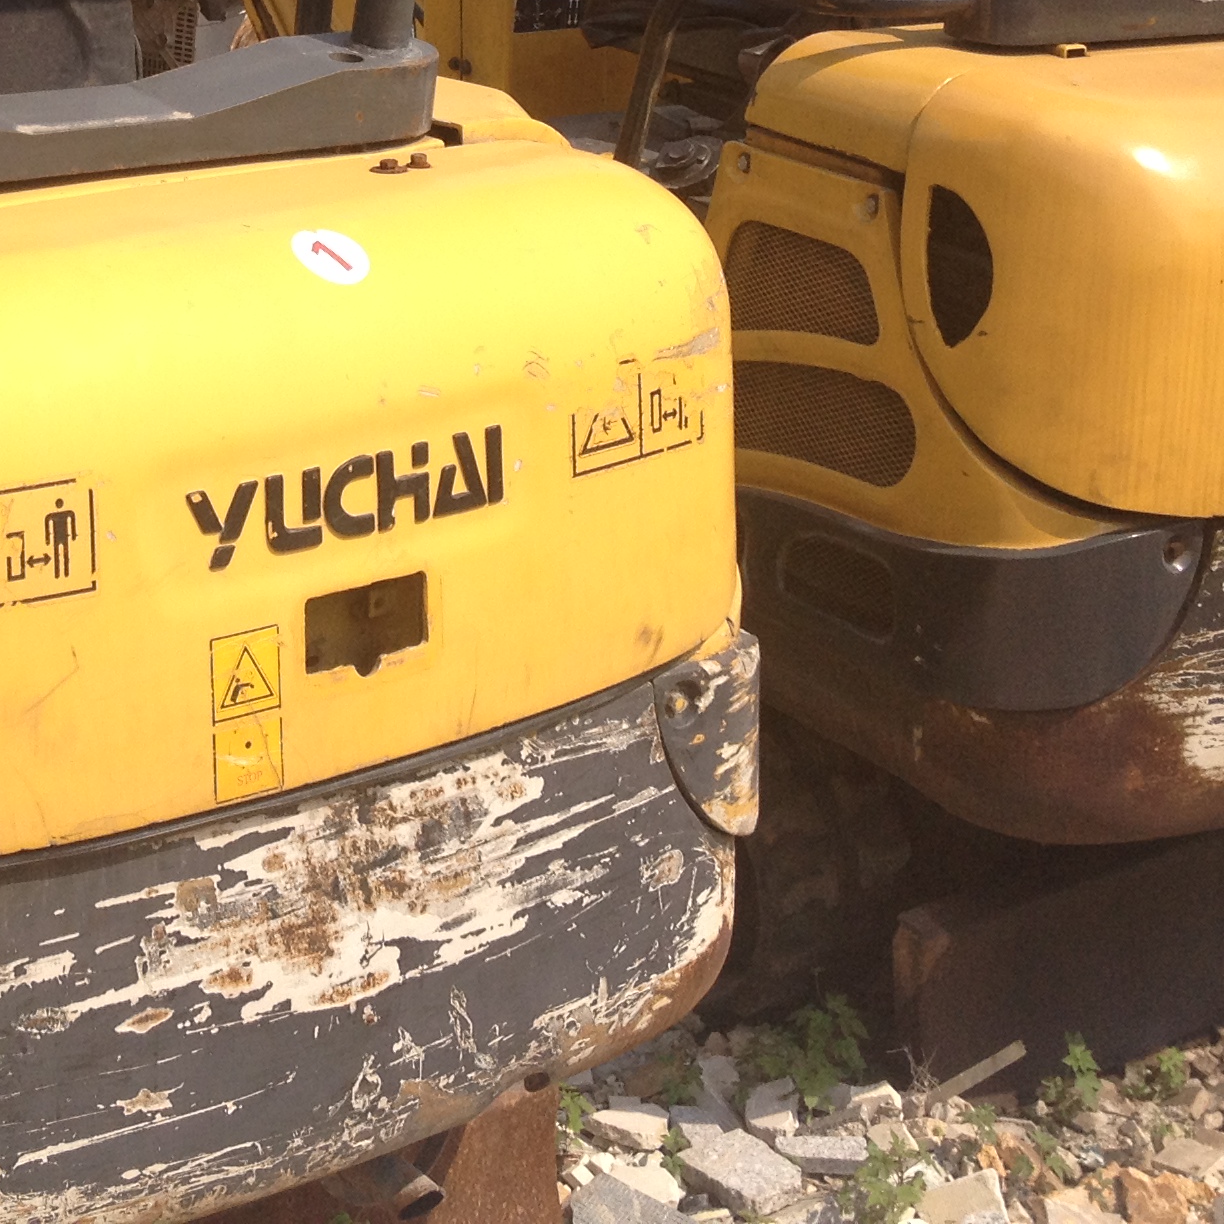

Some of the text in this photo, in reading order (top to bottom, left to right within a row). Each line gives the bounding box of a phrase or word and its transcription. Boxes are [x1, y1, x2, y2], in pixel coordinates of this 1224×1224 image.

[311, 240, 354, 272] 1
[185, 424, 504, 573] YUCHAI
[236, 770, 264, 786] STOP
